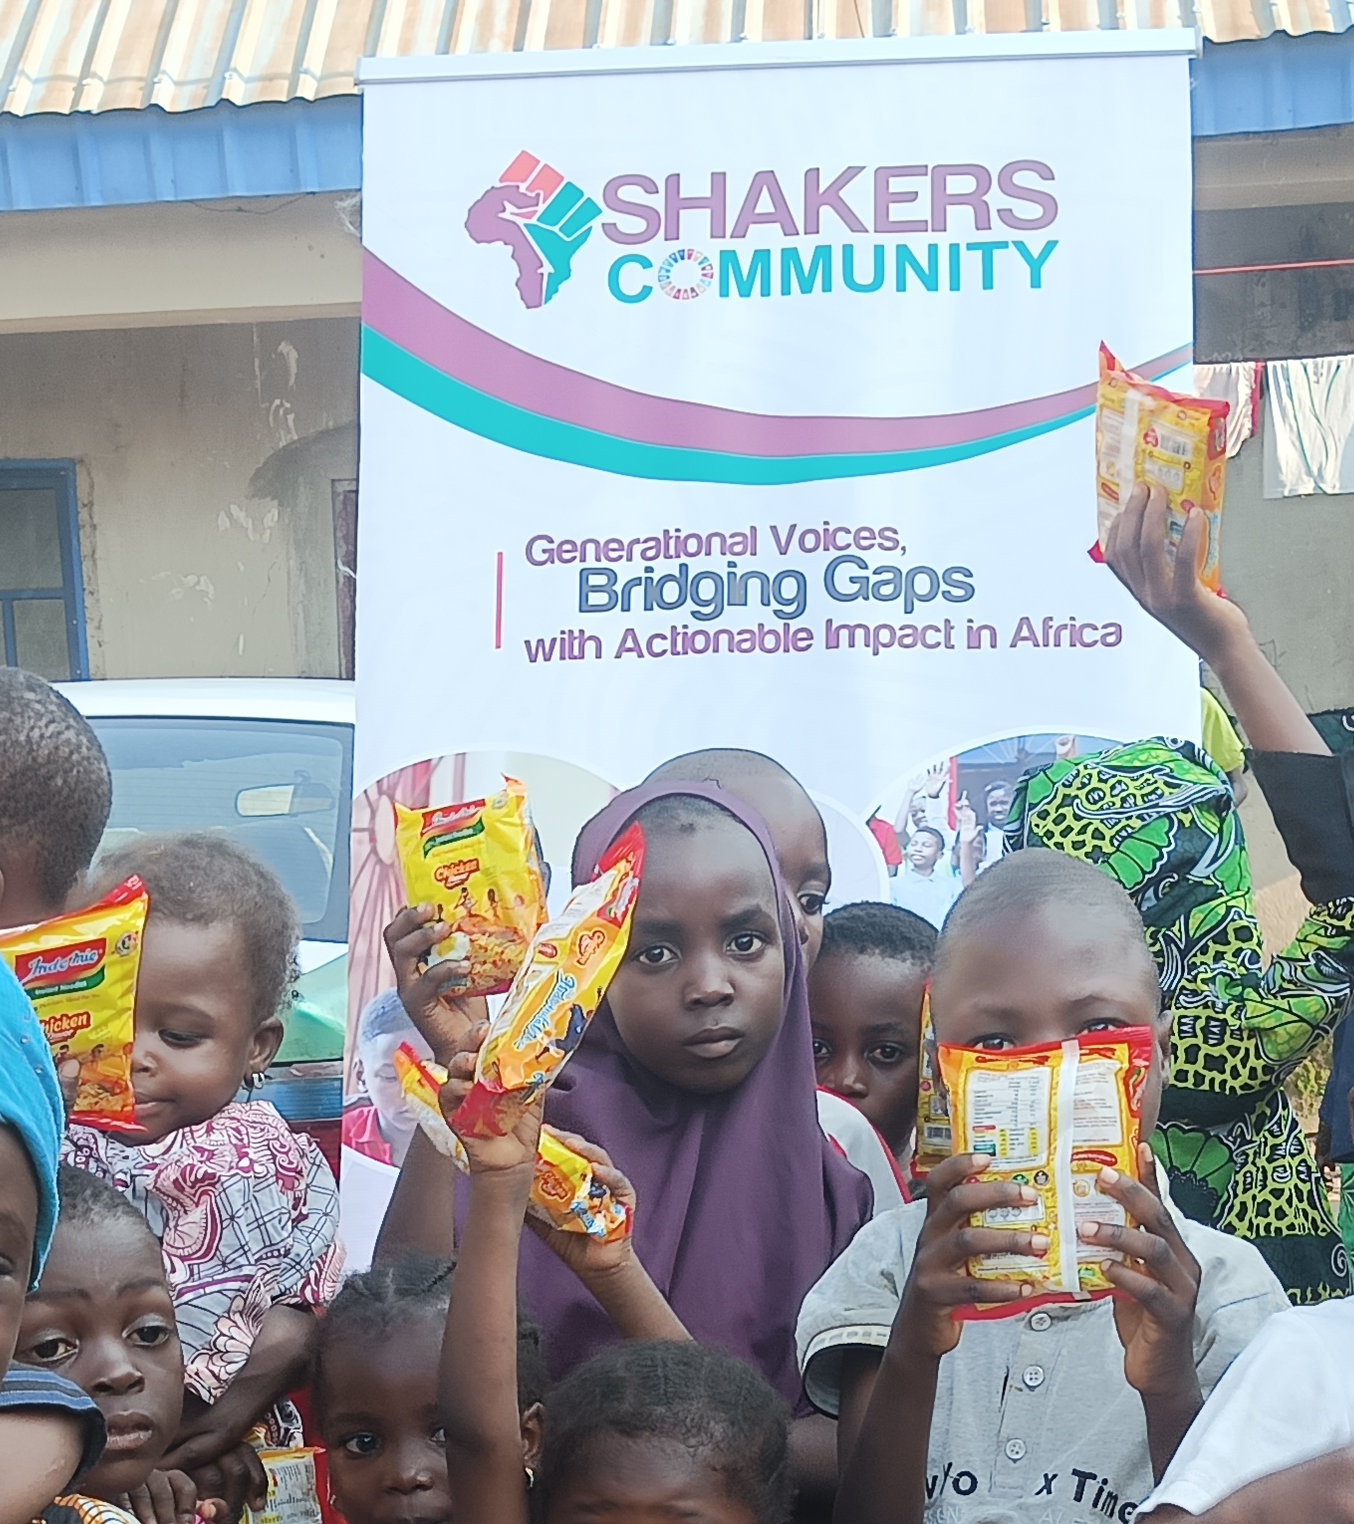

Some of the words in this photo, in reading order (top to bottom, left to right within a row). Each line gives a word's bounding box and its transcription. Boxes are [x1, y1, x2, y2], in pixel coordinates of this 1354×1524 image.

[600, 159, 1059, 246] SHAKERS
[607, 239, 1060, 304] COMMUNITY
[525, 525, 757, 567] Generational
[769, 520, 908, 557] Voices,
[577, 560, 808, 621] Bridging
[822, 554, 976, 614] Gaps
[524, 628, 603, 663] with
[614, 623, 814, 660] Actionable
[825, 618, 955, 656] Impact
[966, 617, 997, 650] in
[1009, 616, 1123, 649] Africa
[41, 1013, 88, 1033] hicken
